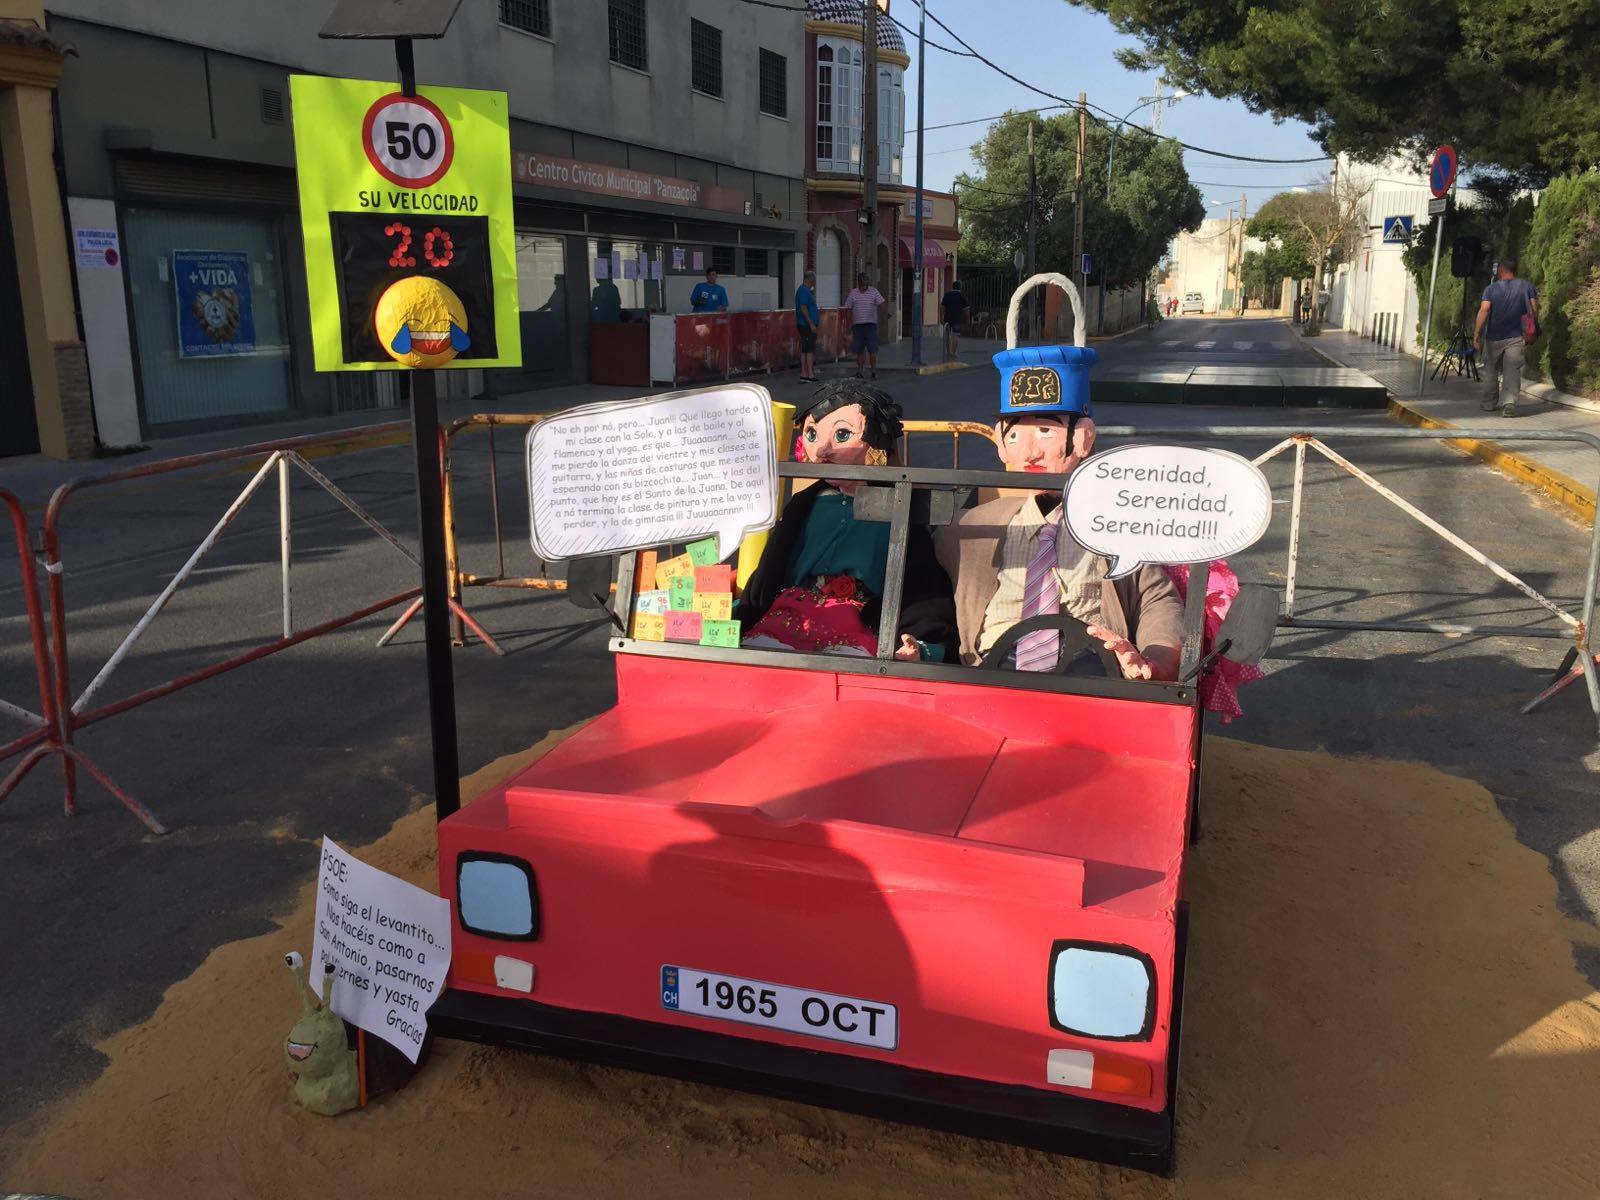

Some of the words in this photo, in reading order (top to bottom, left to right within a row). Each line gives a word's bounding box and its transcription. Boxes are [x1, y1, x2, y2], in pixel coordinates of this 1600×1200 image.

[385, 121, 436, 160] 50
[528, 156, 568, 182] Centro
[572, 164, 604, 187] Cívico
[607, 170, 651, 197] Municipal
[359, 191, 380, 208] SU
[388, 192, 478, 212] VELOCIDAD
[384, 222, 454, 268] 20
[189, 269, 238, 286] +VIDA
[570, 424, 580, 432] eh
[584, 424, 599, 434] por
[618, 419, 644, 430] pero...
[679, 411, 697, 423] Que
[701, 409, 721, 420] llego
[725, 405, 749, 415] tarde
[579, 435, 602, 444] clase
[605, 434, 620, 442] con
[623, 431, 630, 440] la
[658, 430, 663, 438] y
[674, 425, 686, 434] las
[689, 423, 700, 432] de
[704, 420, 724, 430] baile
[728, 421, 733, 430] y
[736, 417, 743, 426] al
[553, 446, 595, 459] flamenco
[598, 449, 602, 457] y
[606, 446, 614, 454] al
[737, 428, 756, 440] Que
[568, 460, 597, 471] pierdo
[601, 458, 608, 467] la
[612, 456, 637, 465] danza
[639, 453, 652, 462] del
[656, 450, 688, 460] vientre
[690, 450, 696, 458] y
[699, 446, 714, 455] mis
[717, 443, 744, 453] clases
[748, 440, 759, 449] de
[552, 483, 600, 496] esperando
[604, 482, 620, 490] con
[722, 470, 727, 479] y
[731, 466, 743, 476] las
[746, 464, 760, 474] del
[596, 473, 601, 481] y
[605, 469, 617, 478] las
[620, 466, 642, 476] niñas
[645, 465, 656, 474] de
[659, 461, 697, 472] costuras
[700, 460, 715, 469] que
[718, 457, 731, 465] me
[1096, 462, 1212, 488] Serenidad,
[578, 505, 614, 517] termina
[617, 505, 625, 514] la
[628, 502, 651, 512] clase
[654, 500, 666, 510] de
[667, 498, 699, 510] pintura
[702, 498, 707, 506] y
[711, 496, 724, 504] me
[726, 492, 734, 502] la
[737, 493, 751, 502] voy
[582, 496, 599, 505] que
[602, 492, 618, 504] hoy
[634, 490, 641, 499] el
[645, 488, 671, 498] Santo
[674, 485, 686, 495] de
[688, 484, 696, 494] la
[731, 478, 743, 488] De
[1116, 490, 1233, 517] Serenidad,
[602, 520, 607, 528] y
[610, 517, 618, 526] la
[622, 516, 632, 525] de
[635, 512, 673, 526] gimnasia
[1091, 516, 1218, 540] Serenidad!!!
[322, 848, 348, 883] PSOE:
[323, 876, 340, 902] Como
[340, 894, 358, 916] siga
[361, 905, 372, 921] el
[376, 908, 445, 951] levantito...
[326, 902, 340, 926] Nos
[341, 914, 374, 946] hacéis
[378, 938, 414, 960] como
[418, 952, 426, 965] a
[320, 920, 330, 941] San
[376, 960, 434, 993] pasarnos
[374, 982, 382, 999] y
[385, 987, 419, 1013] yasta
[664, 990, 678, 1004] CH
[696, 978, 778, 1018] 1965
[802, 997, 886, 1036] OCT
[386, 1009, 422, 1045] Gracias
